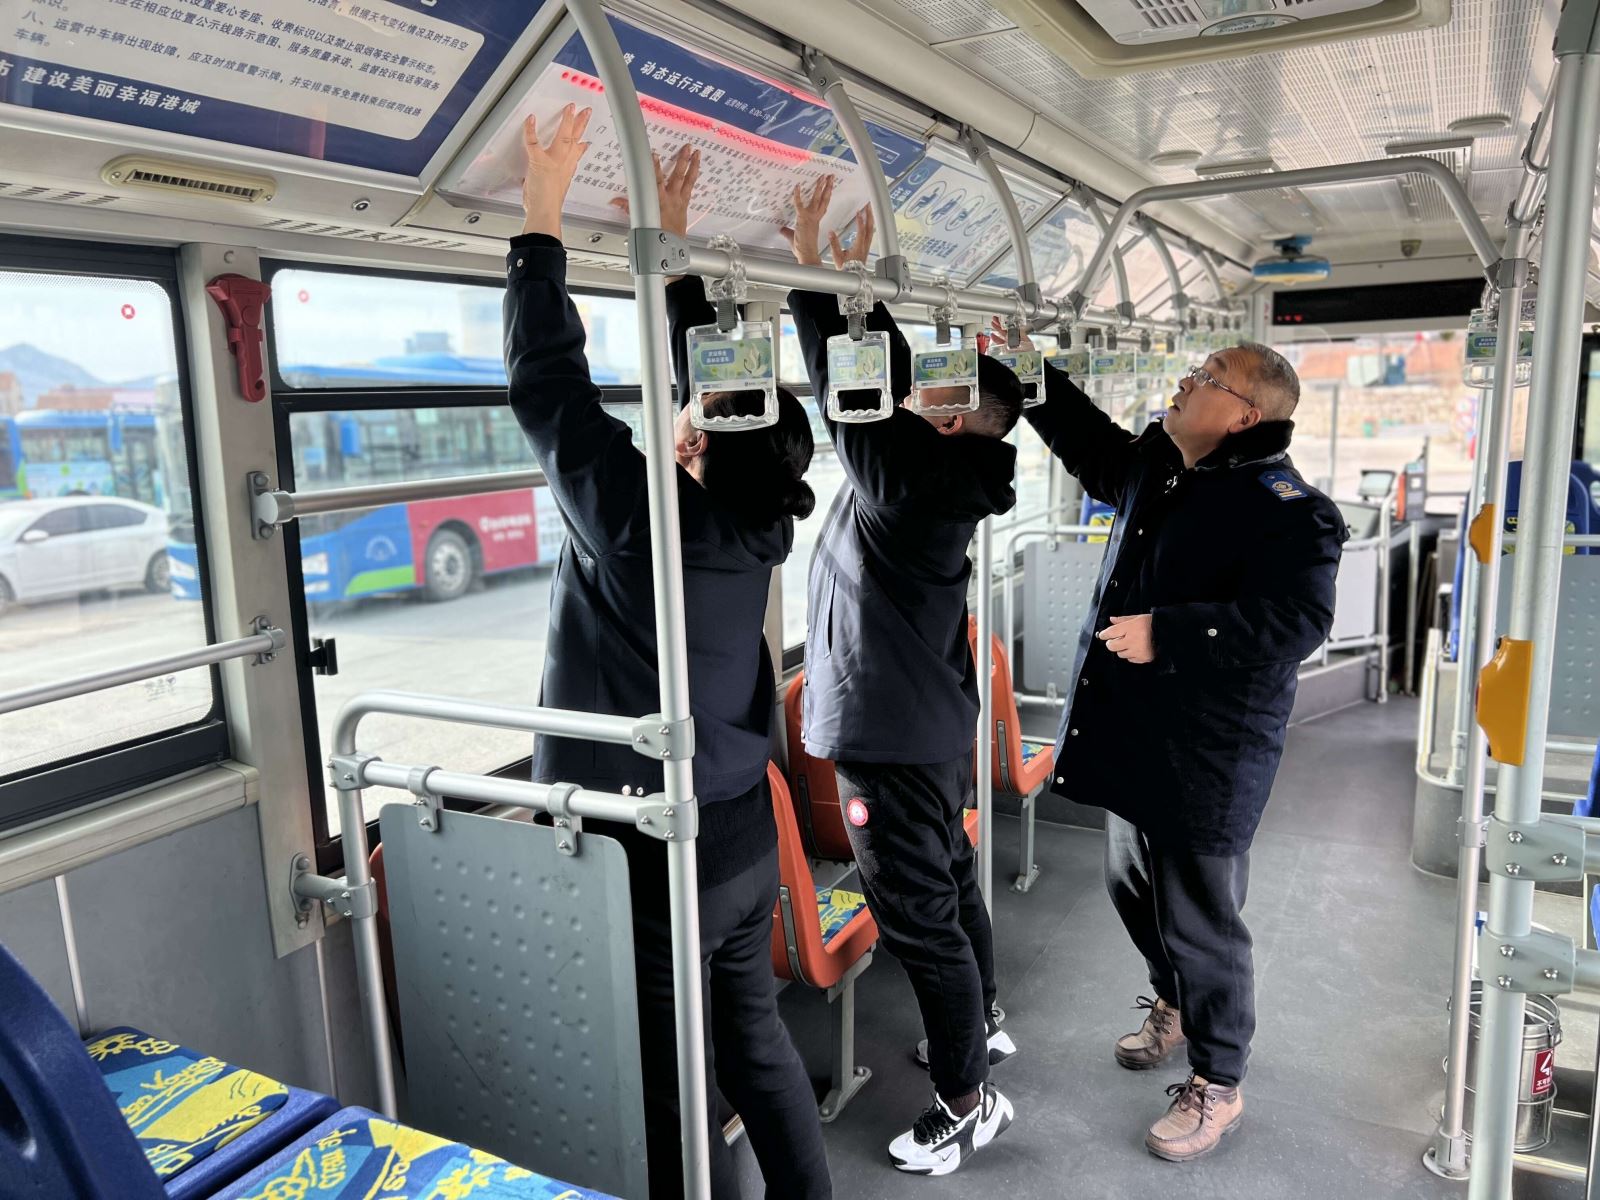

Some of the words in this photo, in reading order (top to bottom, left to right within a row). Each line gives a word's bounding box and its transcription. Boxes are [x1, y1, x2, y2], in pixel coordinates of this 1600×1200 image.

[308, 0, 469, 52] 语言，根据天气变化情况及时开启空
[21, 65, 202, 115] 建设美丽幸福港城
[640, 61, 727, 103] 动态运行示意图
